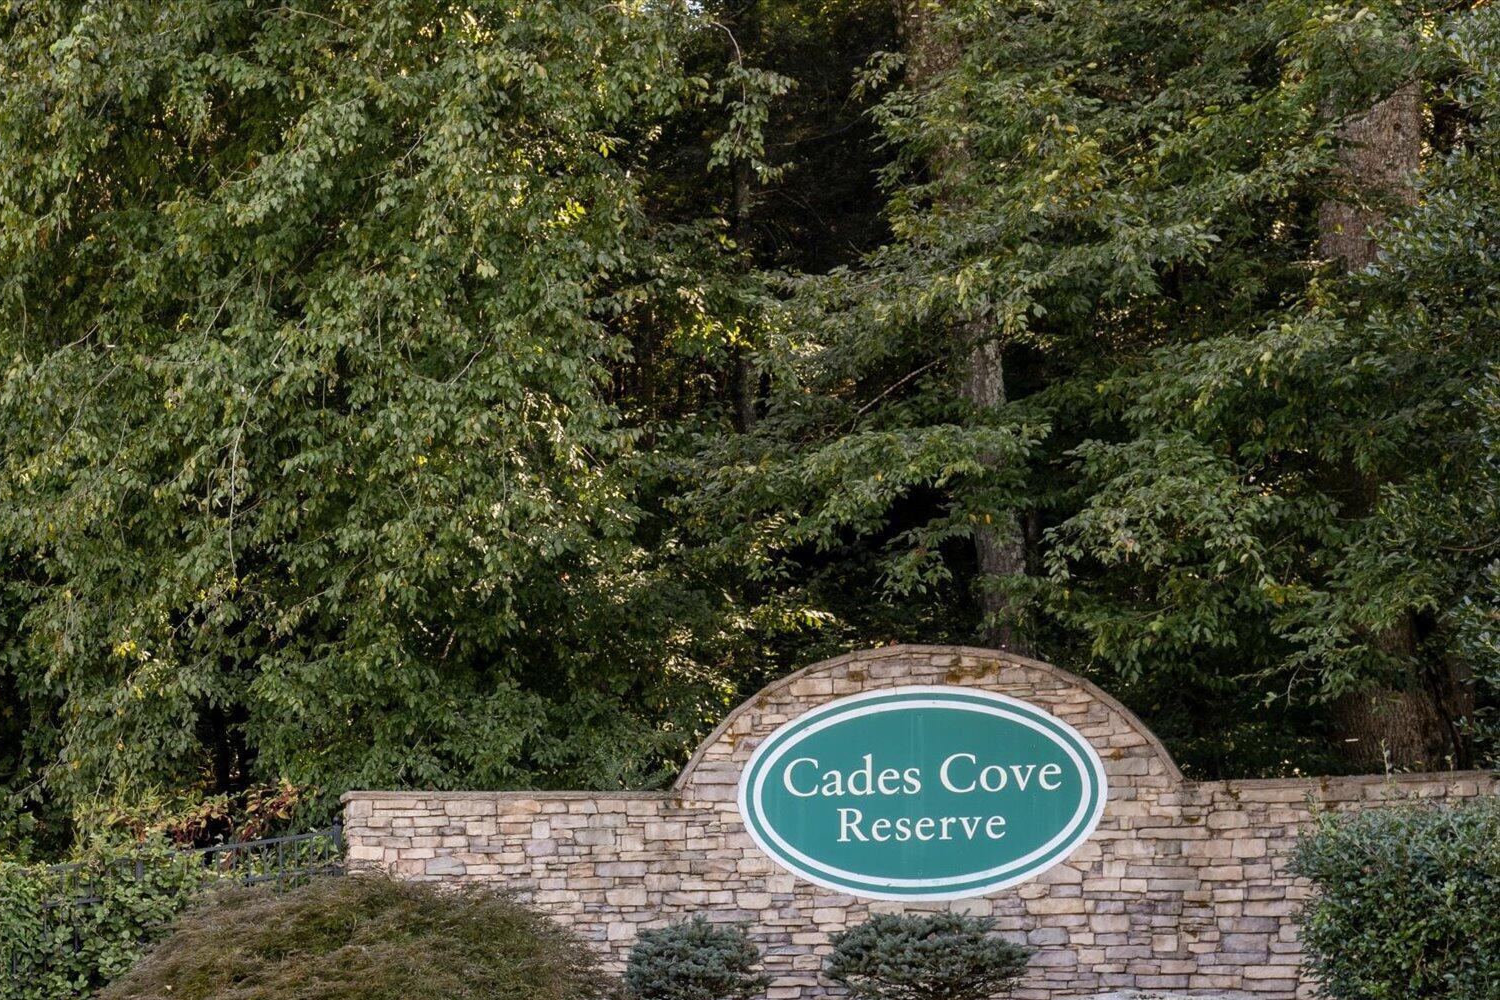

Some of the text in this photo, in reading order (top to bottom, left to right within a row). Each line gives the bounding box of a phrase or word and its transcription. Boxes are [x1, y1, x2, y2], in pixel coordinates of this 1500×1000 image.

[783, 752, 1062, 797] Cades Cove
[836, 807, 1006, 842] Reserve
